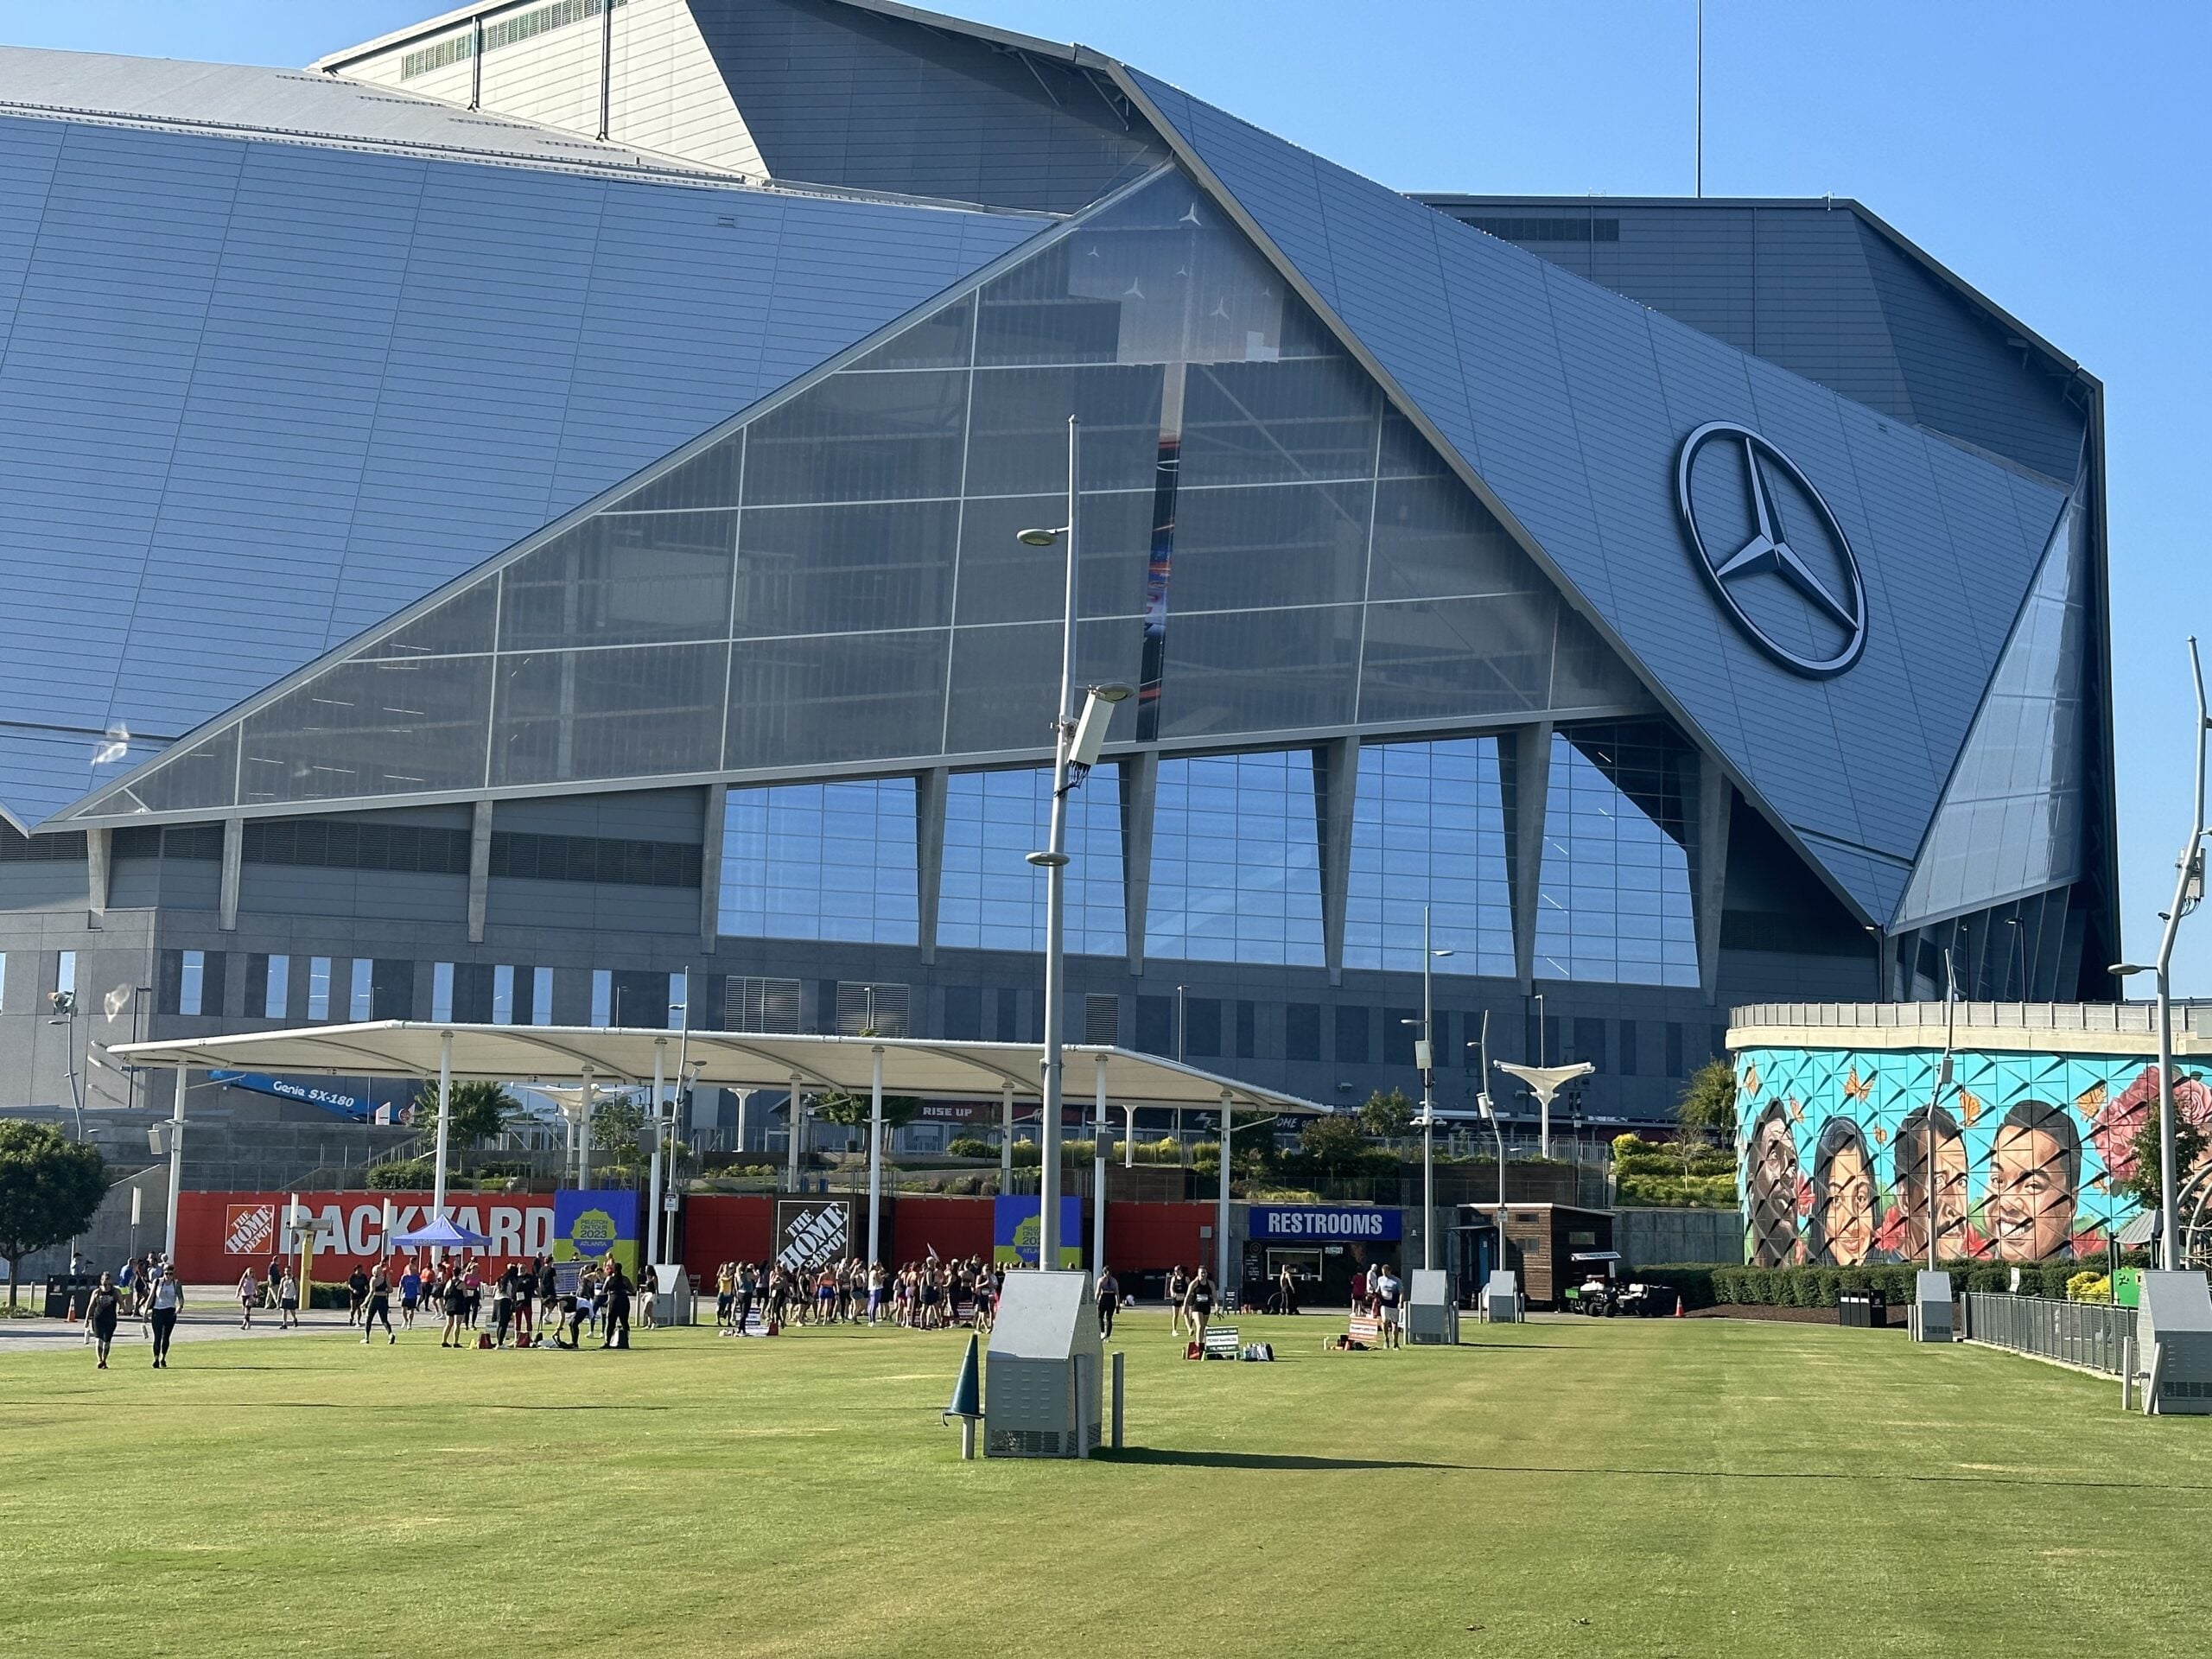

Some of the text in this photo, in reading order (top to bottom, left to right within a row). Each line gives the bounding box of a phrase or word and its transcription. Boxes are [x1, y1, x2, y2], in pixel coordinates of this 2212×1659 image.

[273, 1081, 354, 1108] Genie SX-180
[924, 1107, 972, 1116] RISE UP
[1276, 1117, 1298, 1128] OME
[226, 1205, 273, 1253] HOME
[231, 1210, 251, 1230] THE
[785, 1209, 814, 1238] THE
[1268, 1212, 1382, 1235] RESTROOMS
[243, 1223, 272, 1253] DEPOT
[580, 1230, 607, 1238] 2023
[778, 1202, 848, 1274] HOME
